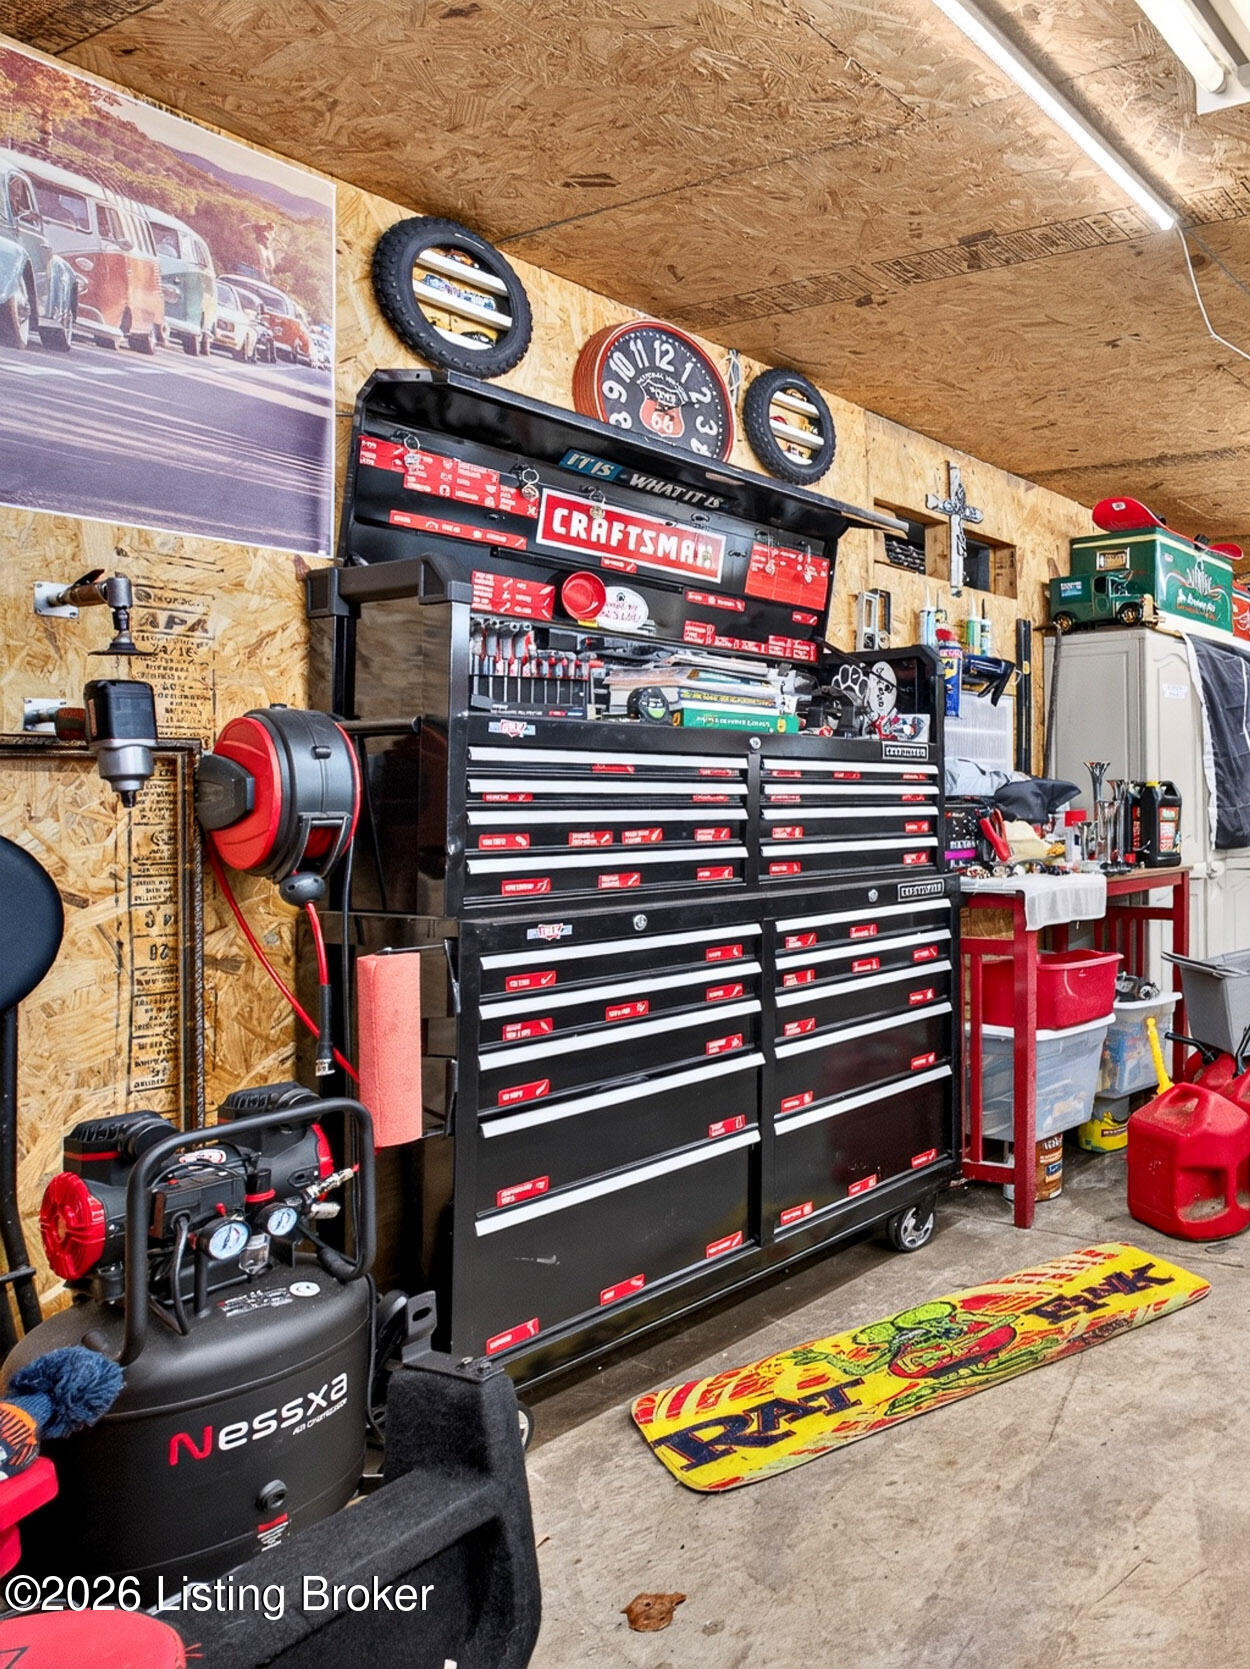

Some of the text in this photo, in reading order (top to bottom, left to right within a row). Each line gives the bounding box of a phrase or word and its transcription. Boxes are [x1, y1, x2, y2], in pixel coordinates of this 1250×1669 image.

[609, 351, 636, 383] 10
[629, 338, 649, 368] 11
[654, 339, 675, 372] 12
[681, 361, 694, 384] 1
[602, 380, 628, 404] 9
[688, 386, 712, 404] 2
[651, 410, 674, 433] 66
[695, 414, 718, 436] 3
[566, 452, 595, 469] IT
[591, 458, 615, 476] IS
[628, 473, 687, 498] WHAT
[551, 507, 714, 570] CRAFTSMAN
[1022, 1262, 1176, 1326] FINK
[168, 1372, 348, 1466] Nessxa
[650, 1377, 865, 1472] RAT
